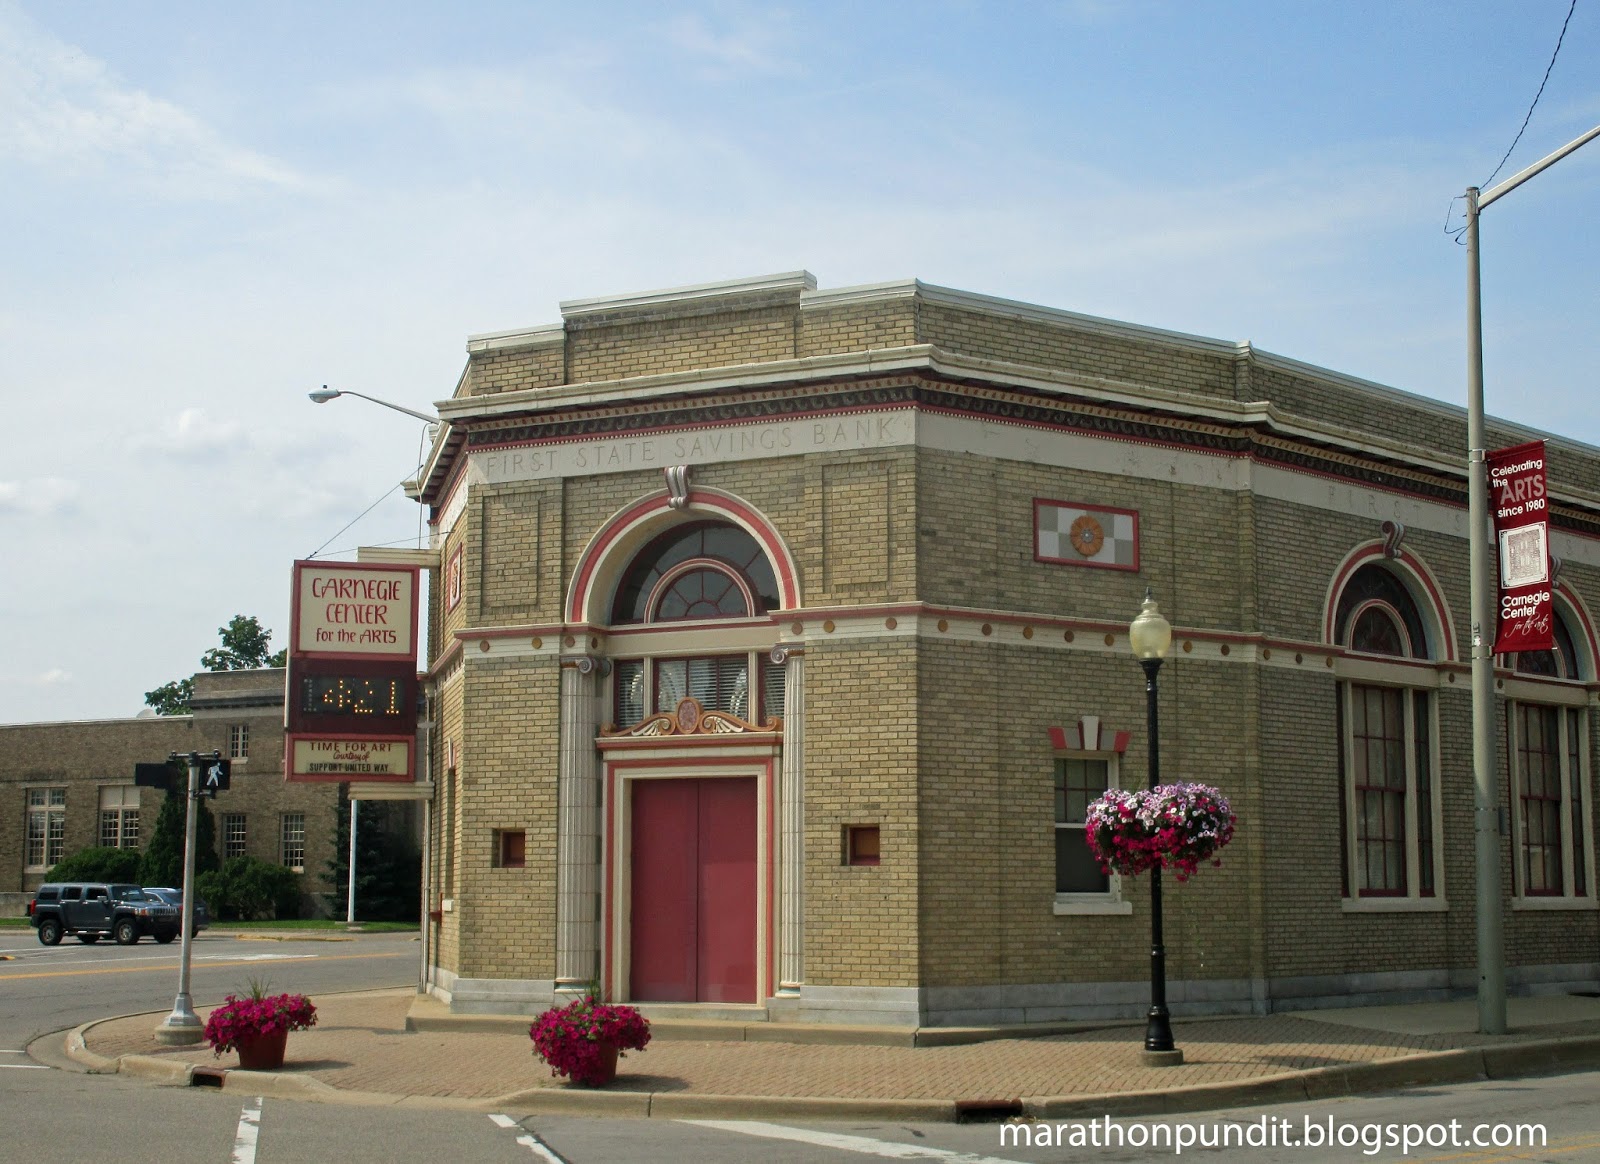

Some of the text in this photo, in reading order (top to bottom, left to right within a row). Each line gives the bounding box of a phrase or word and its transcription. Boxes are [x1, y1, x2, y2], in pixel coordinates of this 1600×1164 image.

[486, 417, 898, 476] FIRST STATE SAVINGS BANK
[1491, 459, 1543, 477] Celebrating
[1492, 474, 1545, 505] the ARTS
[1497, 498, 1545, 518] since 1980
[312, 577, 402, 601] CARNEGIE
[1501, 590, 1550, 607] Carnegie
[326, 603, 388, 625] CENTER
[1501, 605, 1537, 620] Center
[337, 628, 356, 643] the
[359, 629, 397, 644] ARTS
[310, 742, 391, 752] TIME FOR ART
[309, 762, 389, 772] SUPPORT UNITED WAY
